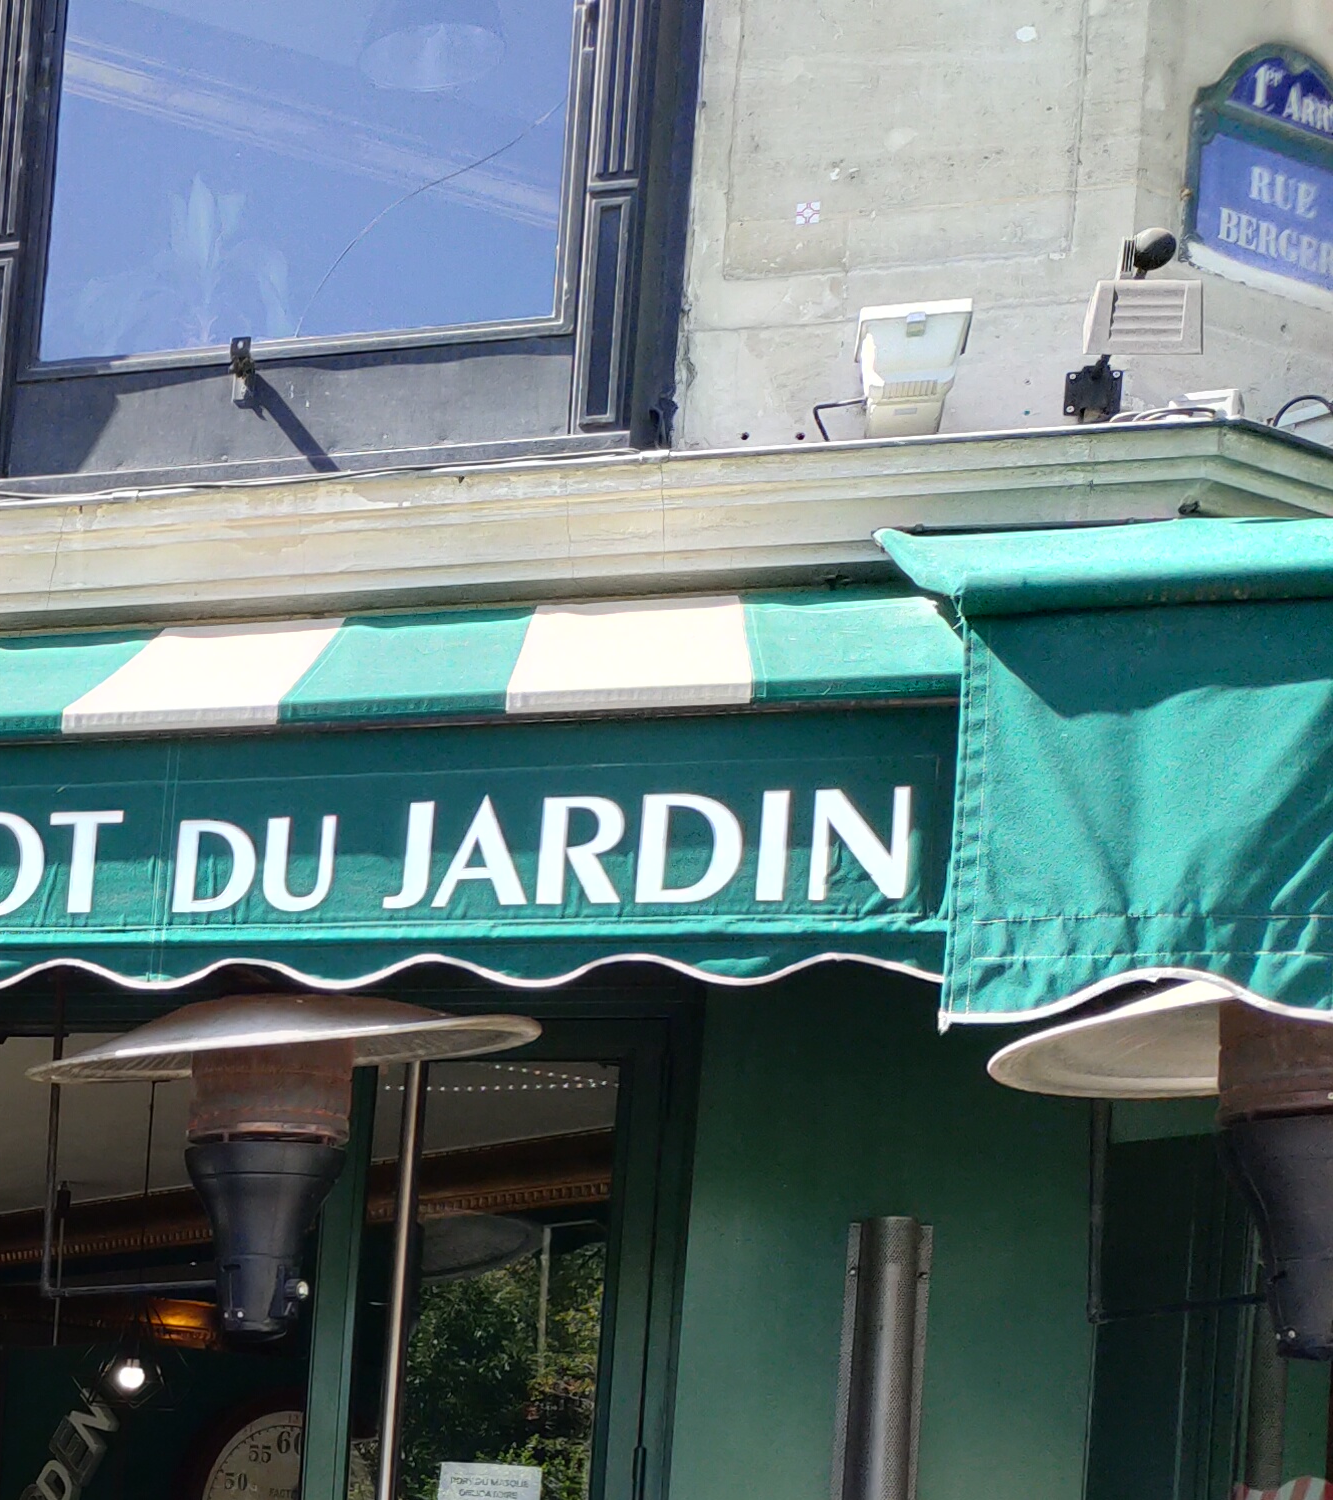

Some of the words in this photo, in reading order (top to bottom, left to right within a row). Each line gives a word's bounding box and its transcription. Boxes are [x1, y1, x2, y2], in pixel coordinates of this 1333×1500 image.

[1248, 165, 1320, 220] RUE
[171, 817, 337, 914] DU
[380, 786, 916, 911] JARDIN
[247, 1444, 272, 1465] 55
[490, 1478, 530, 1488] MASQUE
